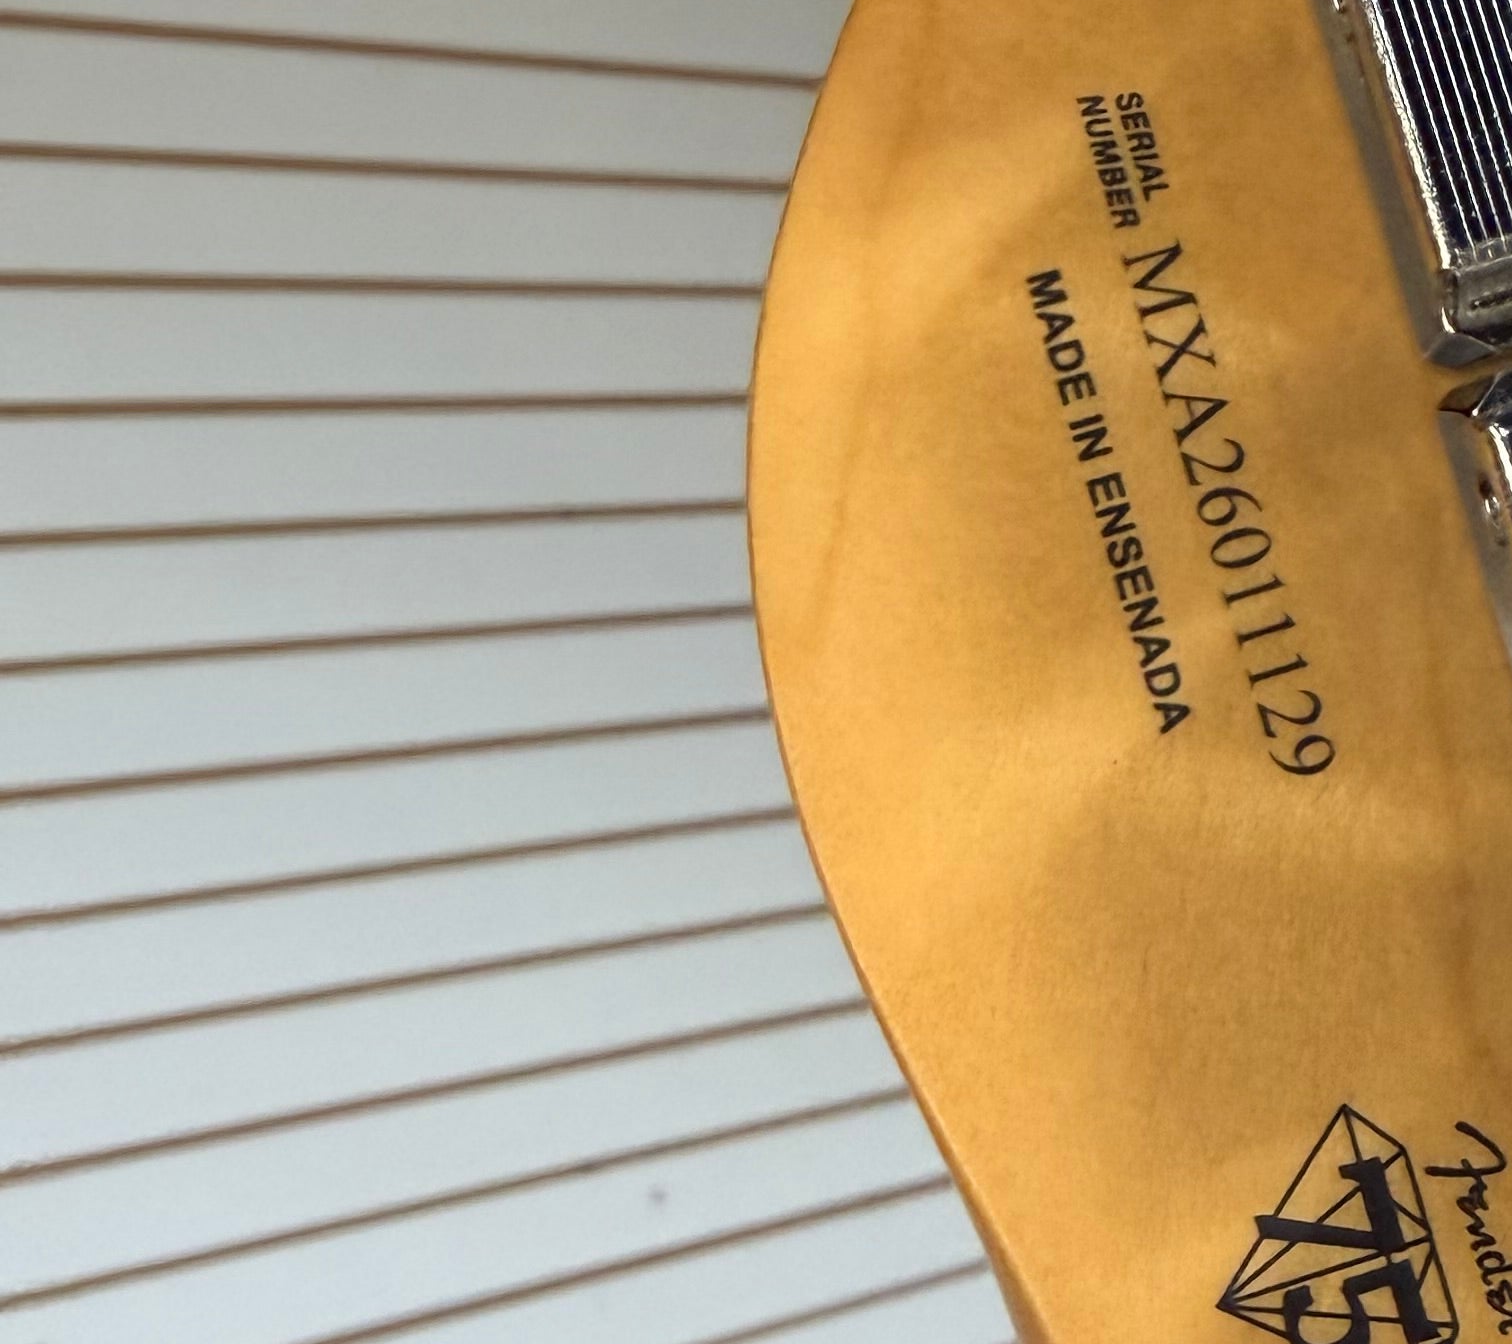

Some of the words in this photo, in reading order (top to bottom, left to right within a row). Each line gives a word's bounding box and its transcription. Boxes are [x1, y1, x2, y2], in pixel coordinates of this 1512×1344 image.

[1076, 94, 1141, 230] NUMBER
[1114, 92, 1170, 203] SERIAL
[1024, 268, 1098, 407] MADE
[1067, 413, 1114, 465] IN
[1121, 239, 1337, 777] MXA26011129
[1084, 472, 1191, 737] ENSENADA
